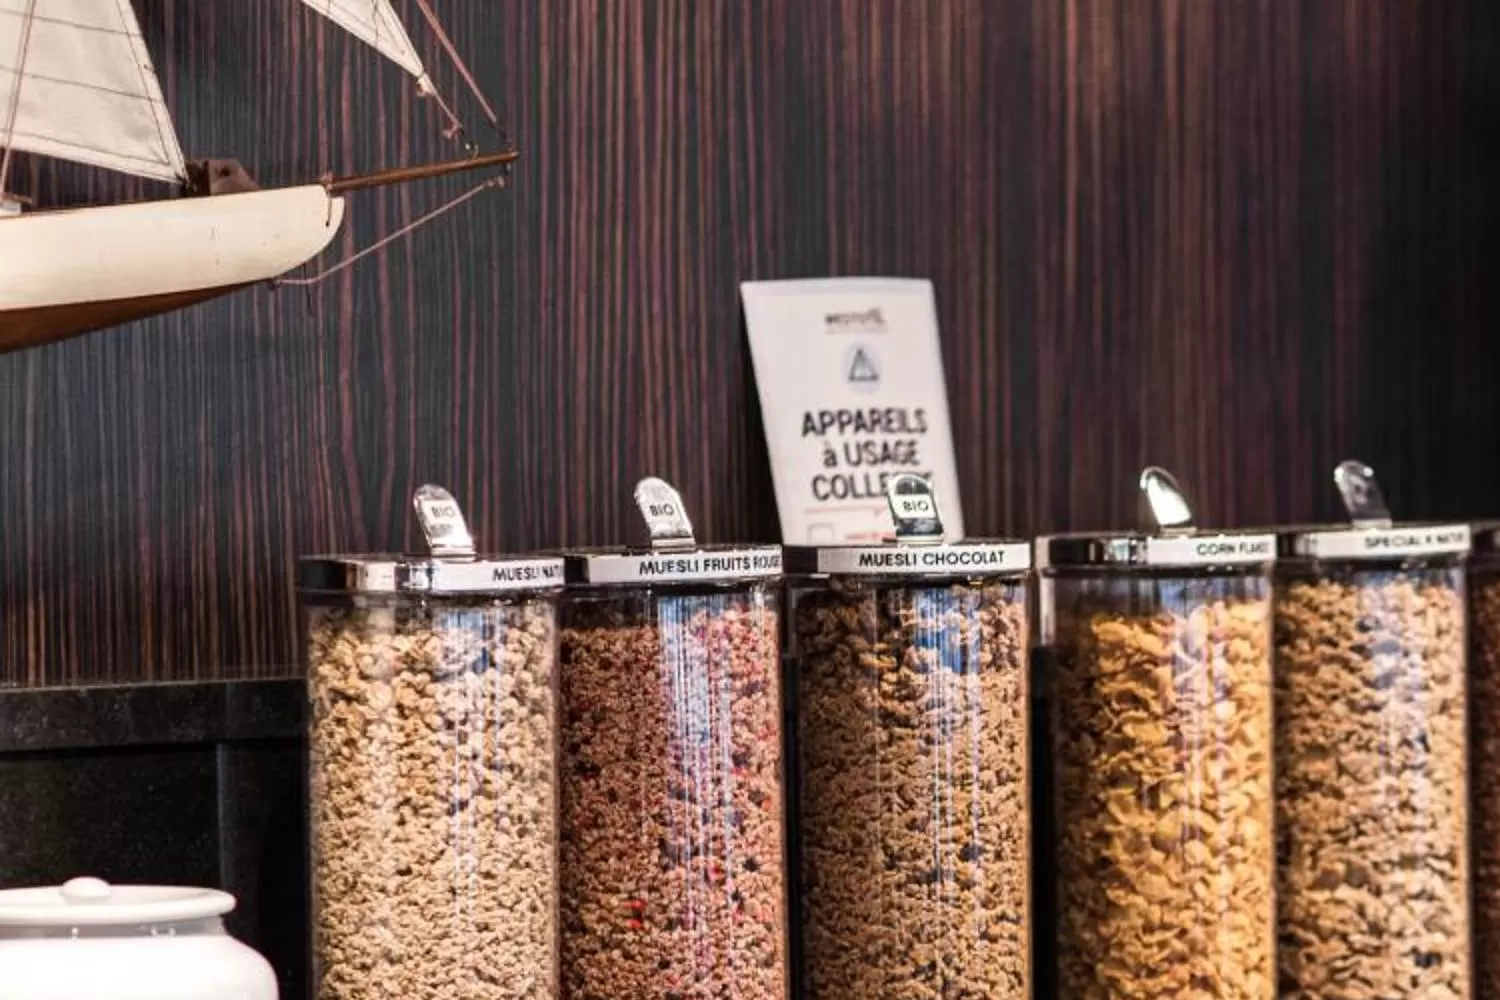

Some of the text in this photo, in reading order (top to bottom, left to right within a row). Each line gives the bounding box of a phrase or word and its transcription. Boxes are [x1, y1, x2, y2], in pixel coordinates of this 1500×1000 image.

[801, 407, 928, 437] APPAREILS
[844, 440, 920, 466] USAGE
[811, 471, 932, 501] COLLE
[431, 505, 457, 518] BIO
[650, 503, 675, 516] BIO
[904, 500, 929, 512] BIO
[858, 550, 1006, 567] MUESLI CHOCOLAT
[1196, 543, 1235, 557] CORN
[492, 565, 539, 582] MUESLI
[639, 559, 699, 575] MUESLI
[703, 556, 751, 573] FRUITS
